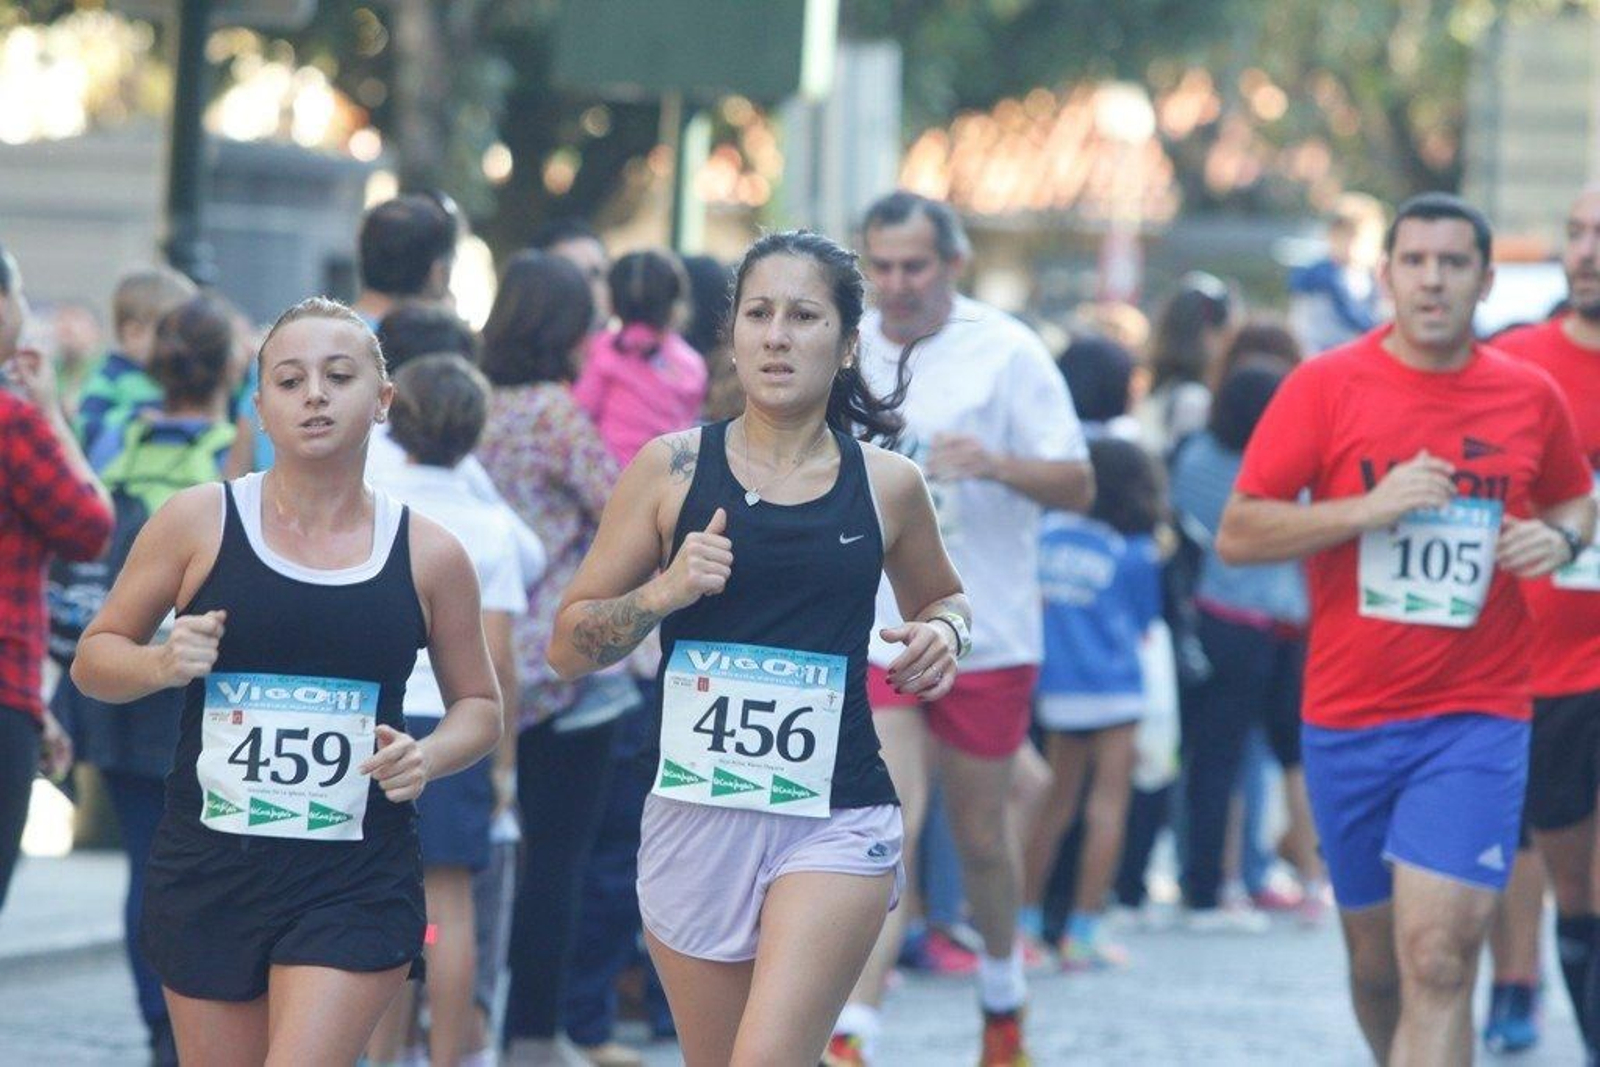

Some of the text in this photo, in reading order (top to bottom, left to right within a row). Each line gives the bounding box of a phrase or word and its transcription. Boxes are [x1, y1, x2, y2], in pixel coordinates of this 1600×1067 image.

[1392, 536, 1482, 585] 105
[227, 726, 351, 787] 459
[693, 696, 816, 762] 456
